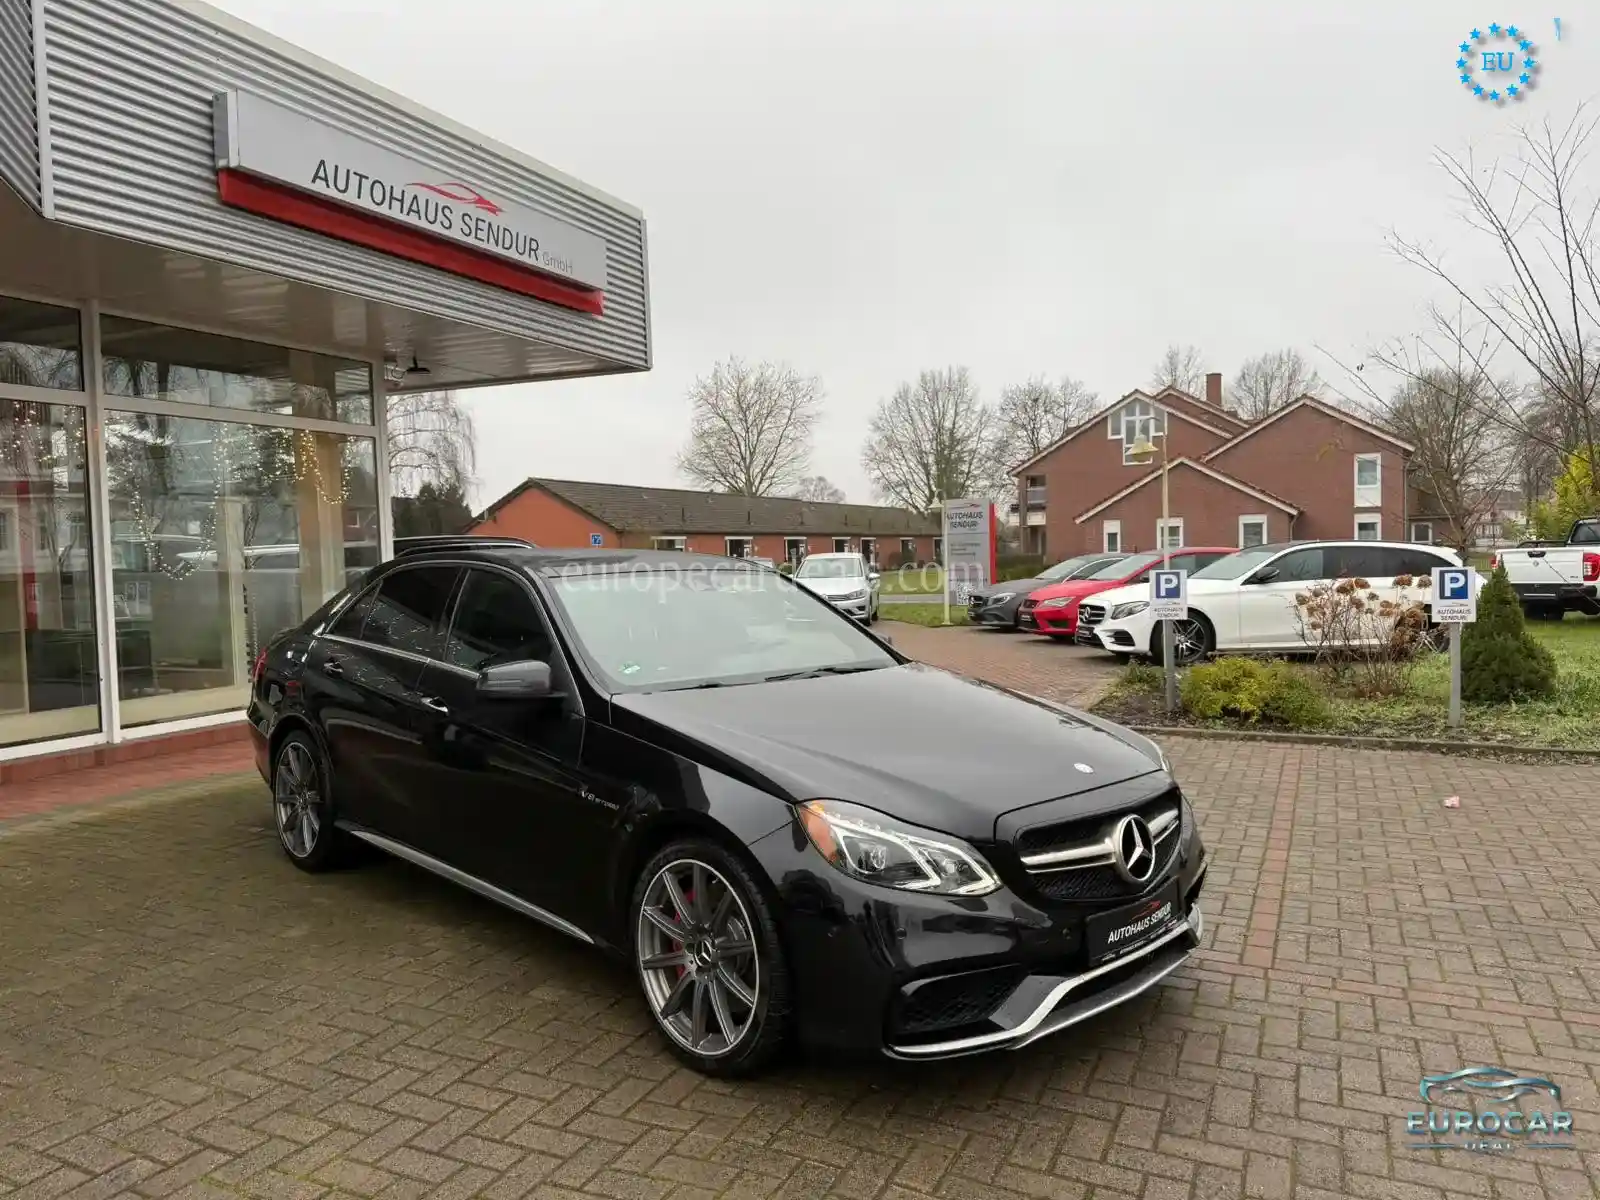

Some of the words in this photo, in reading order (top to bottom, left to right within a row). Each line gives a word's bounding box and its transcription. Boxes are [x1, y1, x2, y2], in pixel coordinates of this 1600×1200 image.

[311, 159, 453, 230] AUTOHAUS
[460, 212, 540, 262] SENDUR
[542, 250, 573, 275] GmbH
[1160, 574, 1178, 597] P
[1444, 572, 1466, 597] P
[1107, 916, 1150, 944] AUTOHAUS
